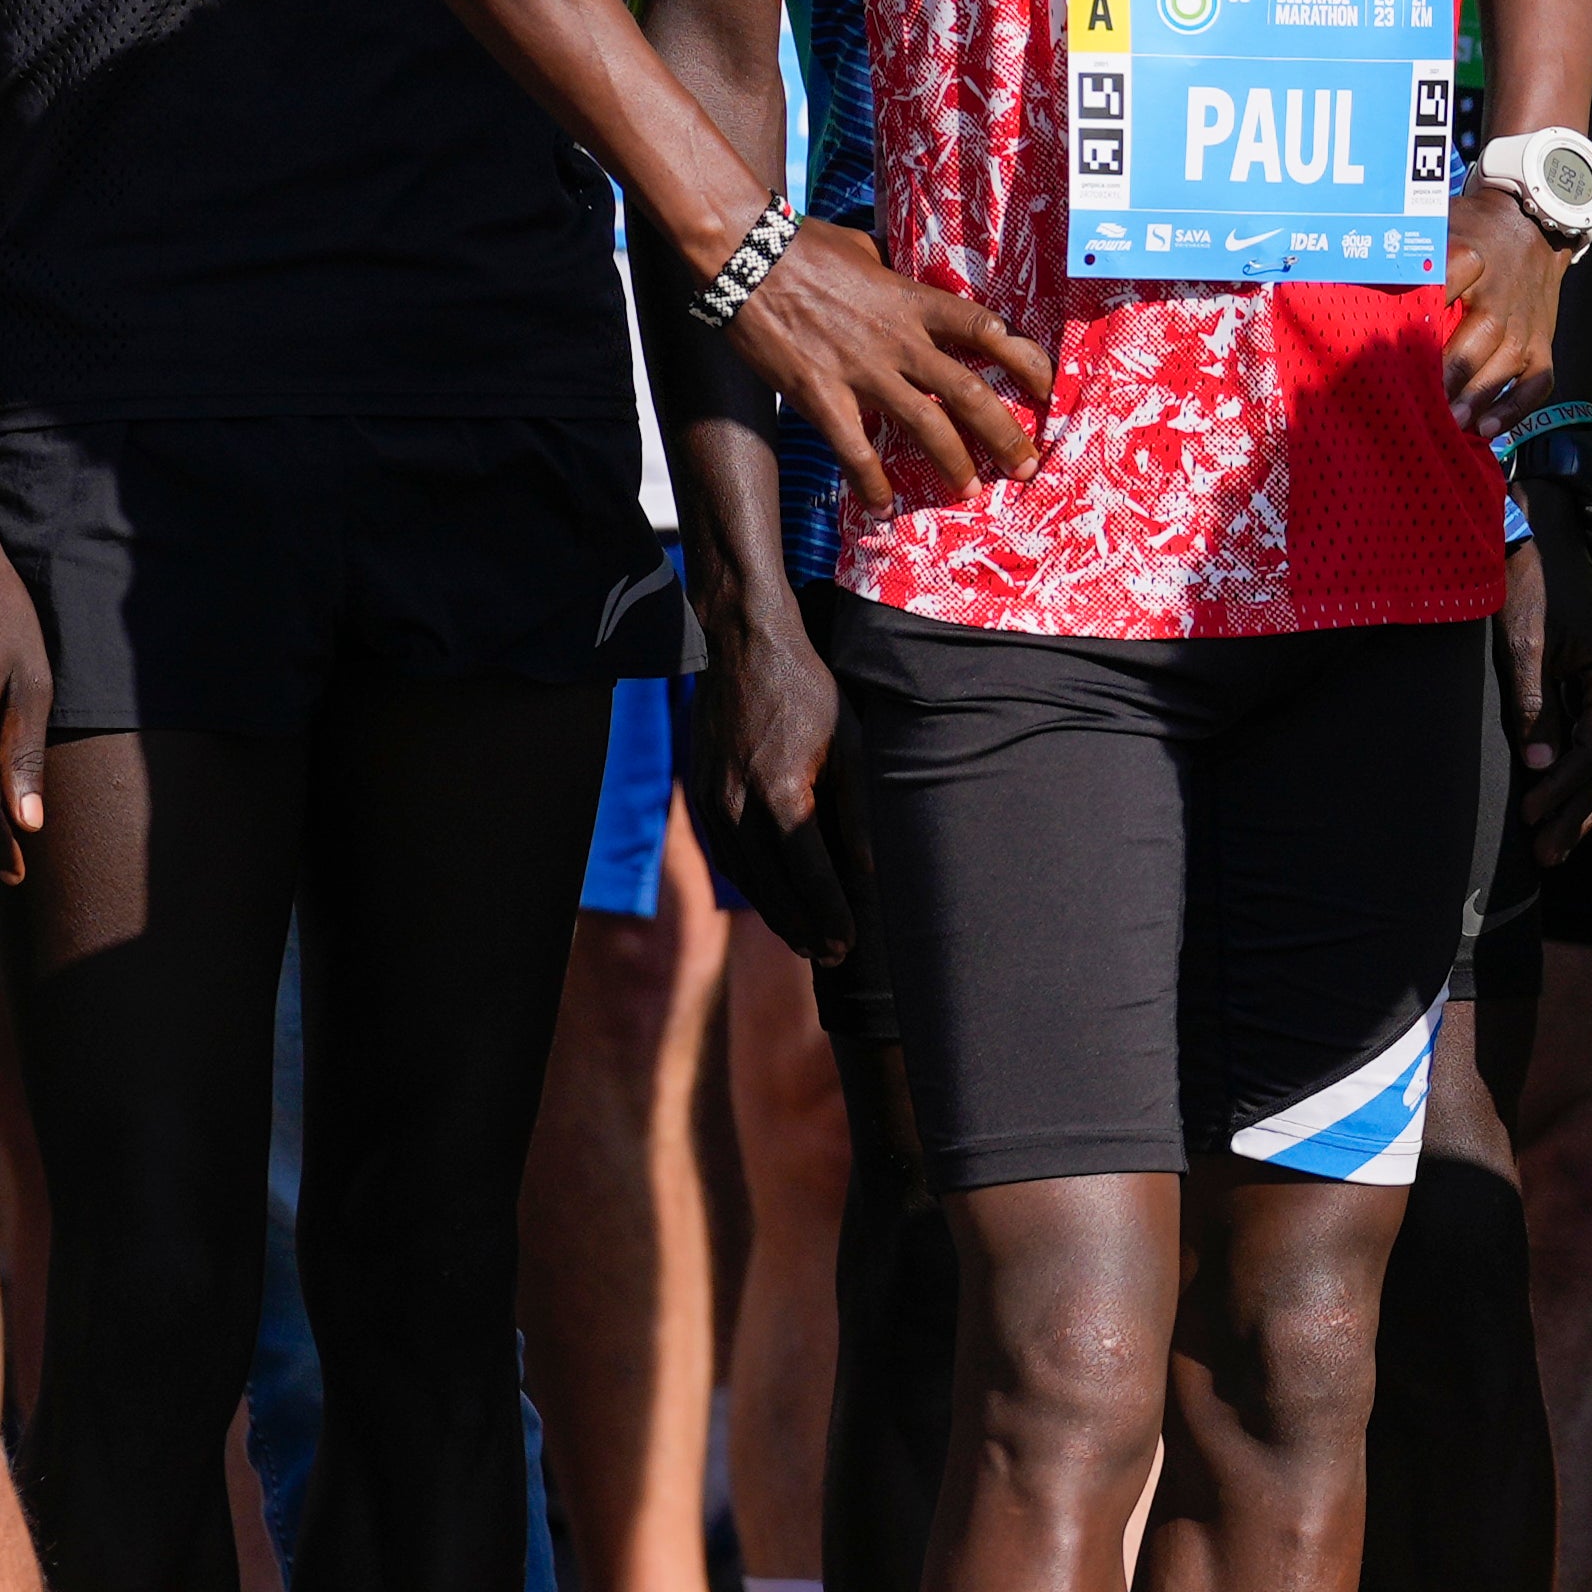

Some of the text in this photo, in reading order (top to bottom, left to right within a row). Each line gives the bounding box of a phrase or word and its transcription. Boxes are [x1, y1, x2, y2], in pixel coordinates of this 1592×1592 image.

[1275, 5, 1433, 27] MARATHON 23 KM
[1184, 85, 1365, 185] PAUL
[1175, 229, 1211, 243] SAVA
[1290, 233, 1329, 251] IDEA
[1085, 239, 1132, 251] ПОШТА
[1343, 246, 1369, 259] viva
